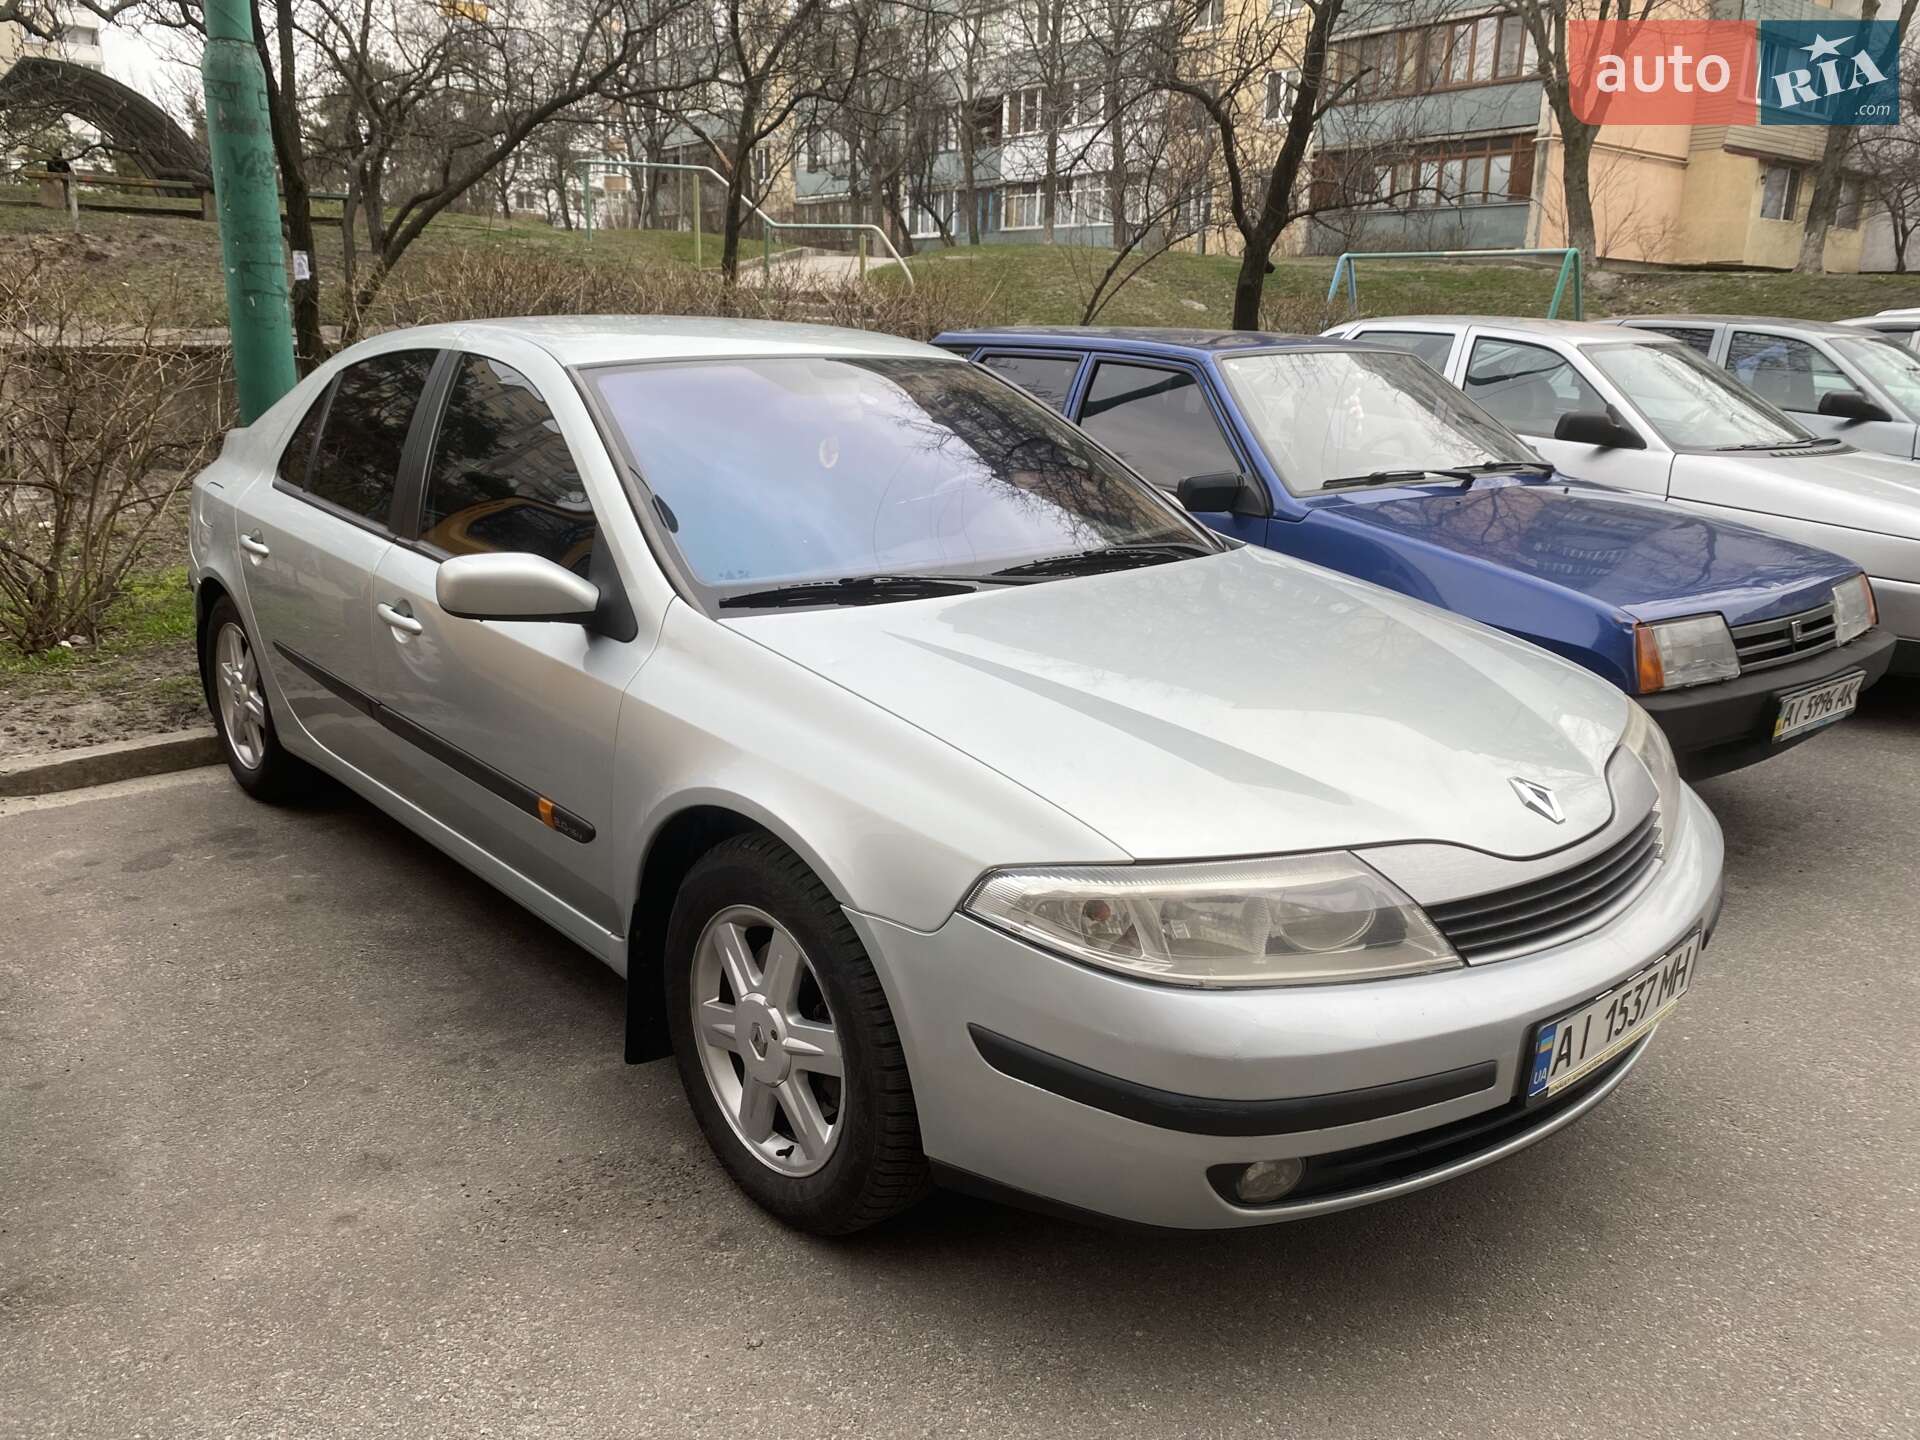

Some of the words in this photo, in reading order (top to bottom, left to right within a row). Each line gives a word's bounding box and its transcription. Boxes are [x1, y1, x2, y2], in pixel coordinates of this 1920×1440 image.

[1782, 700, 1802, 730] AI
[1804, 688, 1838, 720] 5996
[1835, 683, 1857, 711] AK
[1550, 1014, 1592, 1076] AI
[1605, 971, 1659, 1043] 1537
[1656, 946, 1692, 1007] MH
[1533, 1067, 1547, 1084] UA
